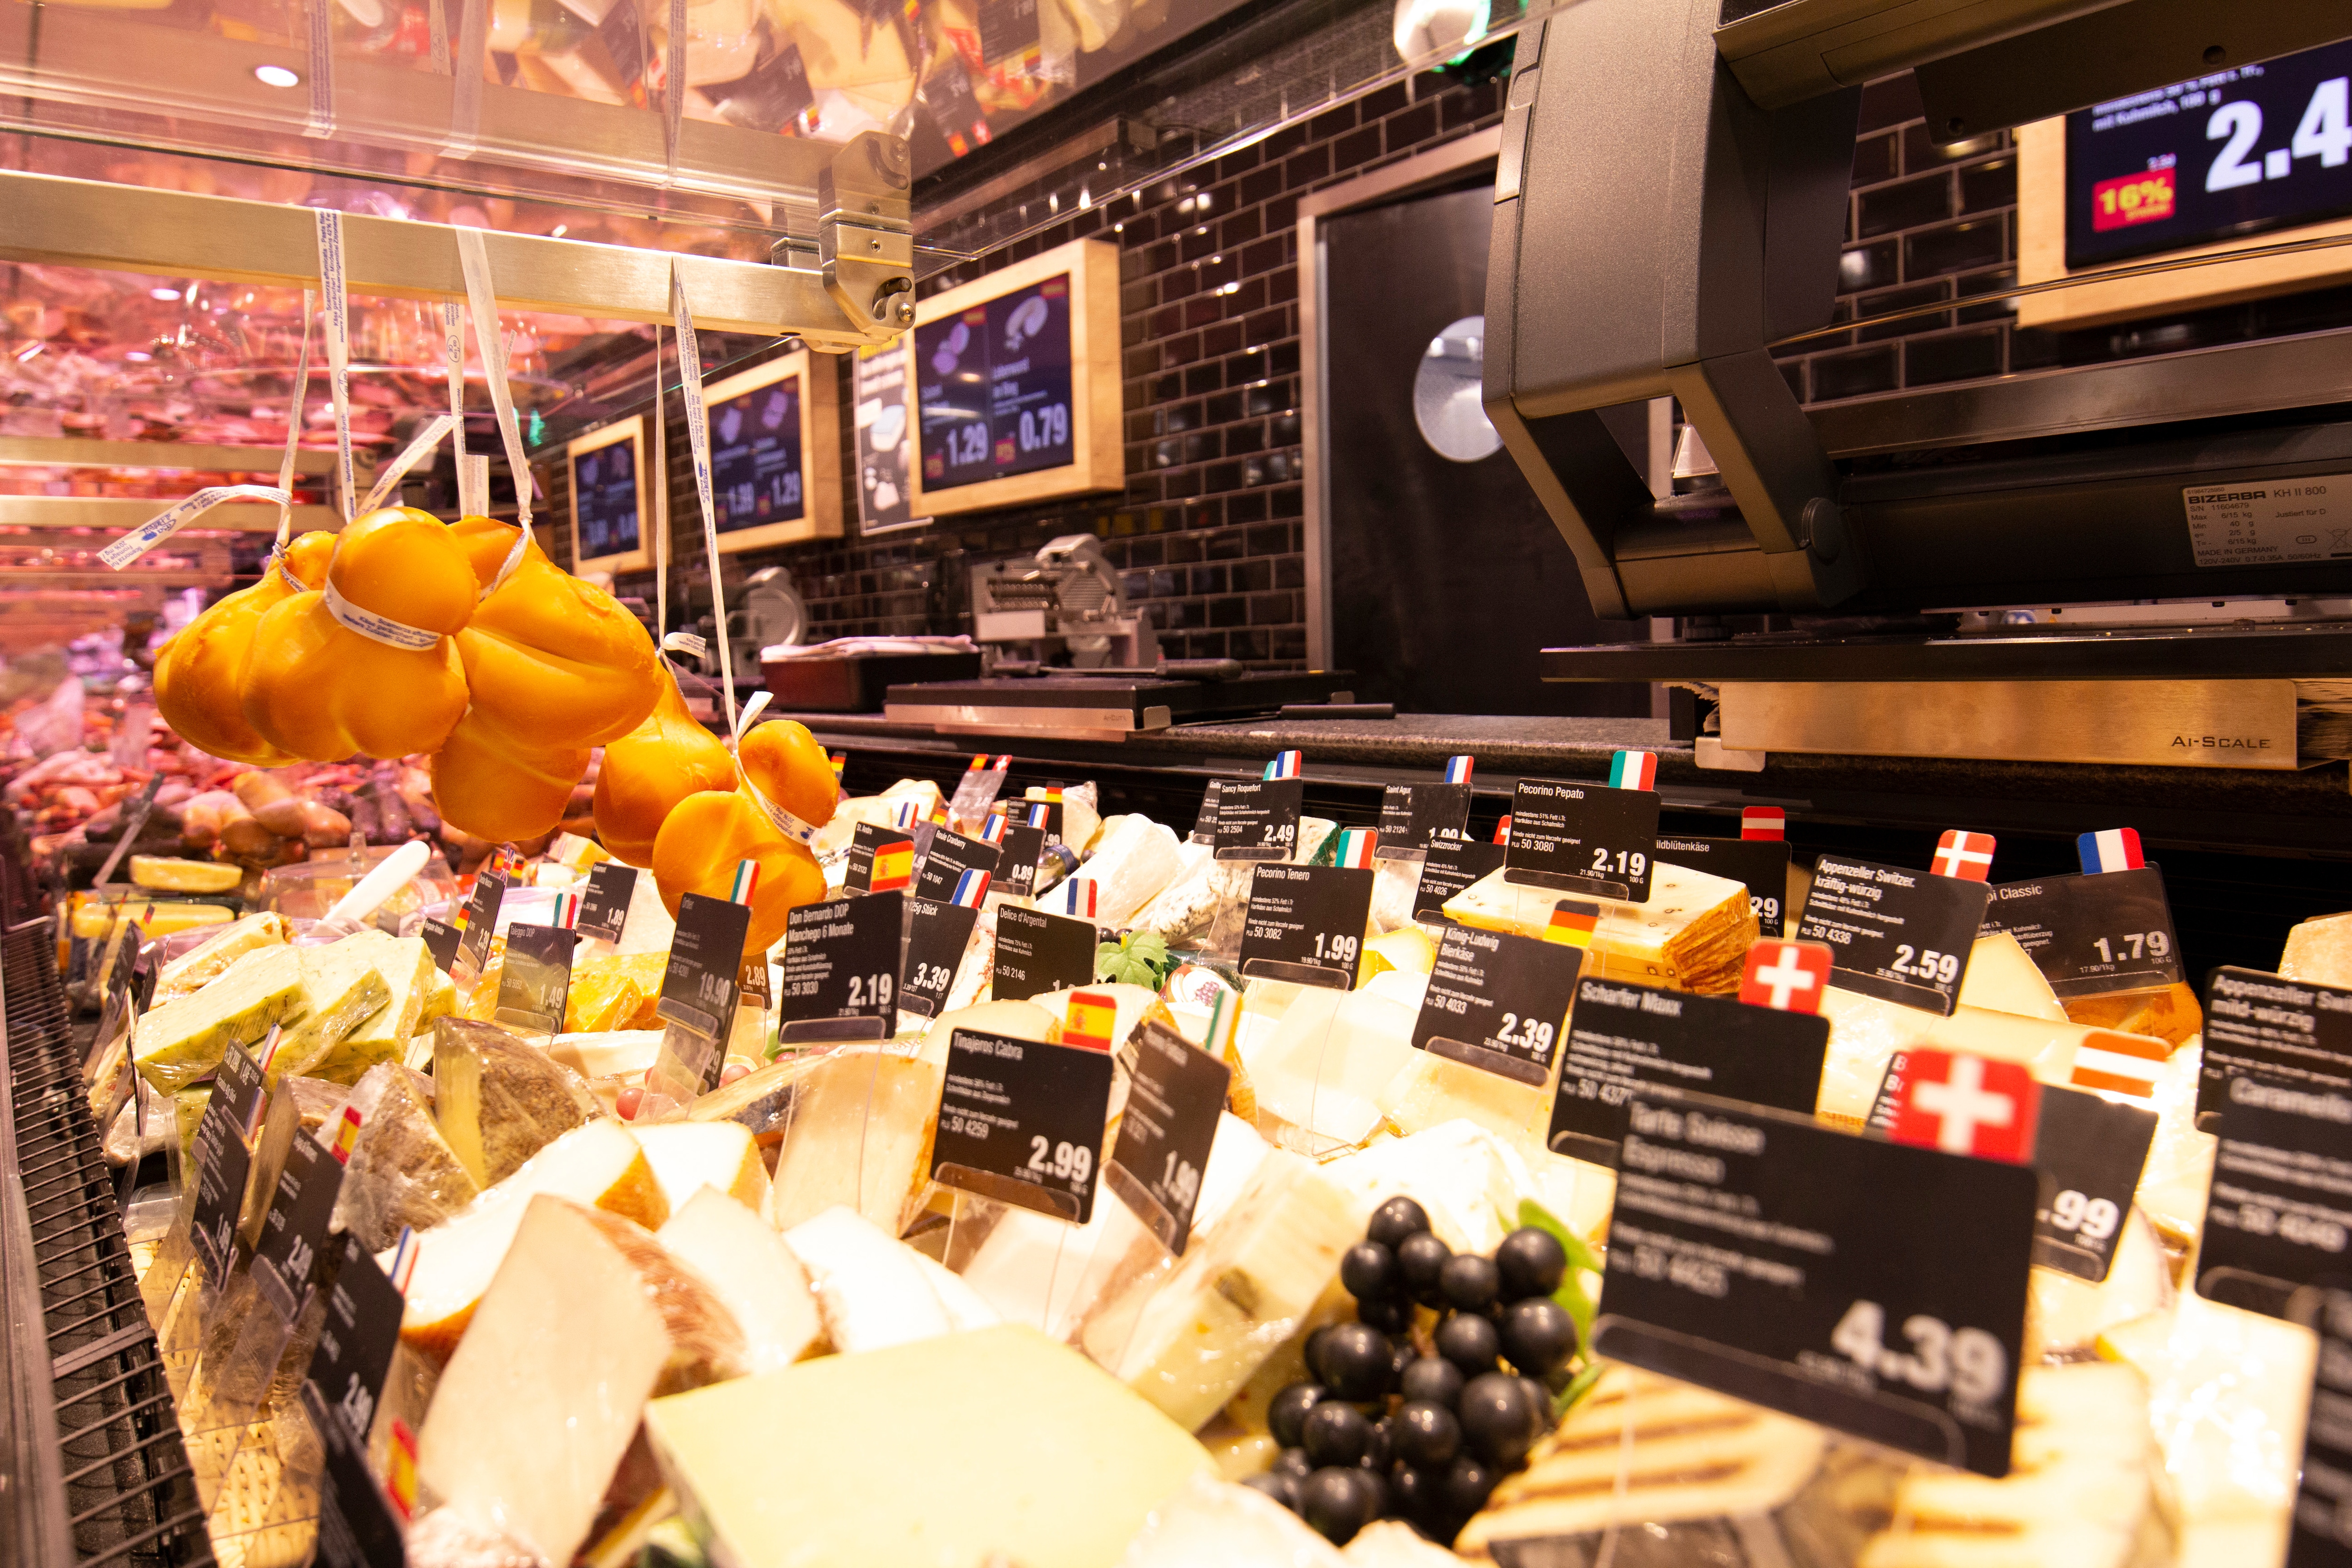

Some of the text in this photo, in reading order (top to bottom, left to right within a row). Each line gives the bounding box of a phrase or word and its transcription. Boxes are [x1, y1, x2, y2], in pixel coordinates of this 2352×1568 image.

[2098, 178, 2173, 215] 16%
[1020, 403, 1068, 452] 0.79
[947, 422, 987, 467] 1.29
[2188, 491, 2266, 503] BIZERBA
[2274, 489, 2290, 498] KH
[2305, 486, 2326, 495] 800
[2276, 510, 2304, 518] Justiert
[1222, 784, 1261, 794] Sancy Roquefort
[1386, 786, 1411, 795] Saint Agur
[1518, 783, 1584, 799] Pecorino Pepato
[946, 834, 966, 850] Cranberry
[1263, 824, 1295, 842] 2.49
[1430, 839, 1462, 852] Swizzrocker
[1521, 839, 1532, 850] 50
[1534, 840, 1554, 852] 3080
[1656, 840, 1709, 852] ildblütenkäse
[1592, 848, 1645, 876] 2.19
[1818, 859, 1875, 880] Appenzeller
[926, 872, 943, 885] 50 1047
[1012, 864, 1034, 881] 0.89
[1256, 866, 1310, 881] Pecorino Tenero
[1580, 869, 1604, 879] 21.90/1kg
[1426, 884, 1447, 896] 50 4026
[2000, 885, 2042, 900] Classic
[608, 907, 624, 926] 1.89
[789, 903, 849, 924] Don Bernardo DOP
[922, 903, 938, 916] Stück
[1000, 907, 1047, 928] Delice d'Argental
[510, 925, 535, 938] Taleggio DOP
[788, 922, 854, 943] Manchego 6 Monate
[1254, 926, 1263, 938] 50
[1264, 928, 1281, 940] 3082
[1813, 925, 1826, 939] 50
[2013, 924, 2042, 932] Kuhmilch
[478, 928, 490, 950] 2.39
[1315, 932, 1358, 962] 1.99
[1446, 927, 1500, 953] König-Ludwig
[2093, 931, 2170, 963] 1.79
[1440, 943, 1475, 962] Bierkäse
[1002, 965, 1009, 976] 50
[1011, 968, 1025, 980] 2146
[1891, 944, 1959, 984] 2.59
[507, 978, 511, 987] 50
[746, 965, 766, 987] 2.89
[914, 962, 950, 992] 3.39
[540, 984, 564, 1009] 1.49
[699, 971, 731, 1008] 19.90
[792, 982, 801, 995] 50
[848, 972, 892, 1007] 2.19
[1434, 994, 1467, 1014] 50 4033
[1497, 1012, 1553, 1052] 2.39
[951, 1115, 964, 1133] 50
[1027, 1135, 1092, 1184] 2.99
[1831, 1299, 2007, 1408] 4.39
